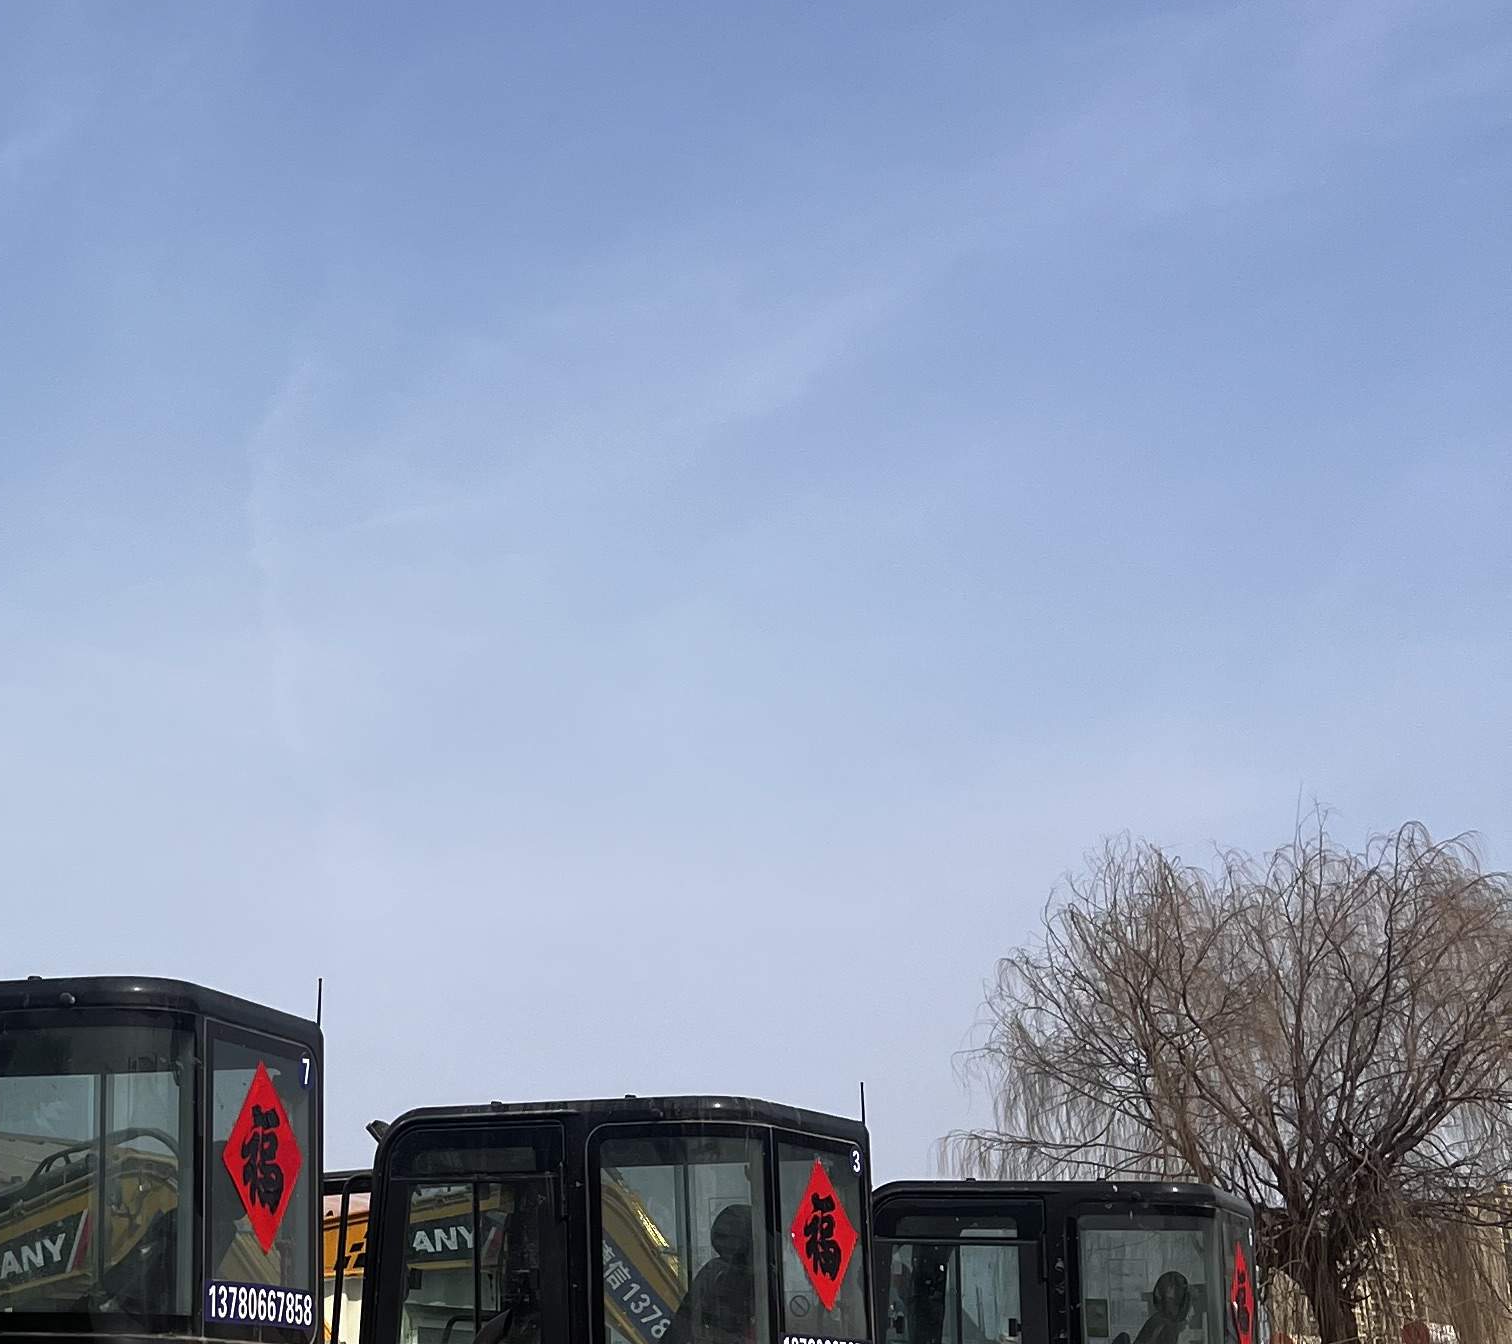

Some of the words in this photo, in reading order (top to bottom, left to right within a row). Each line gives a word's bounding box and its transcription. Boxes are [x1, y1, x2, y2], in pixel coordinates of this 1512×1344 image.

[302, 1058, 311, 1085] 7
[241, 1104, 284, 1215] 福
[852, 1150, 861, 1173] 3
[804, 1193, 842, 1281] 福
[208, 1285, 313, 1327] 13780667858
